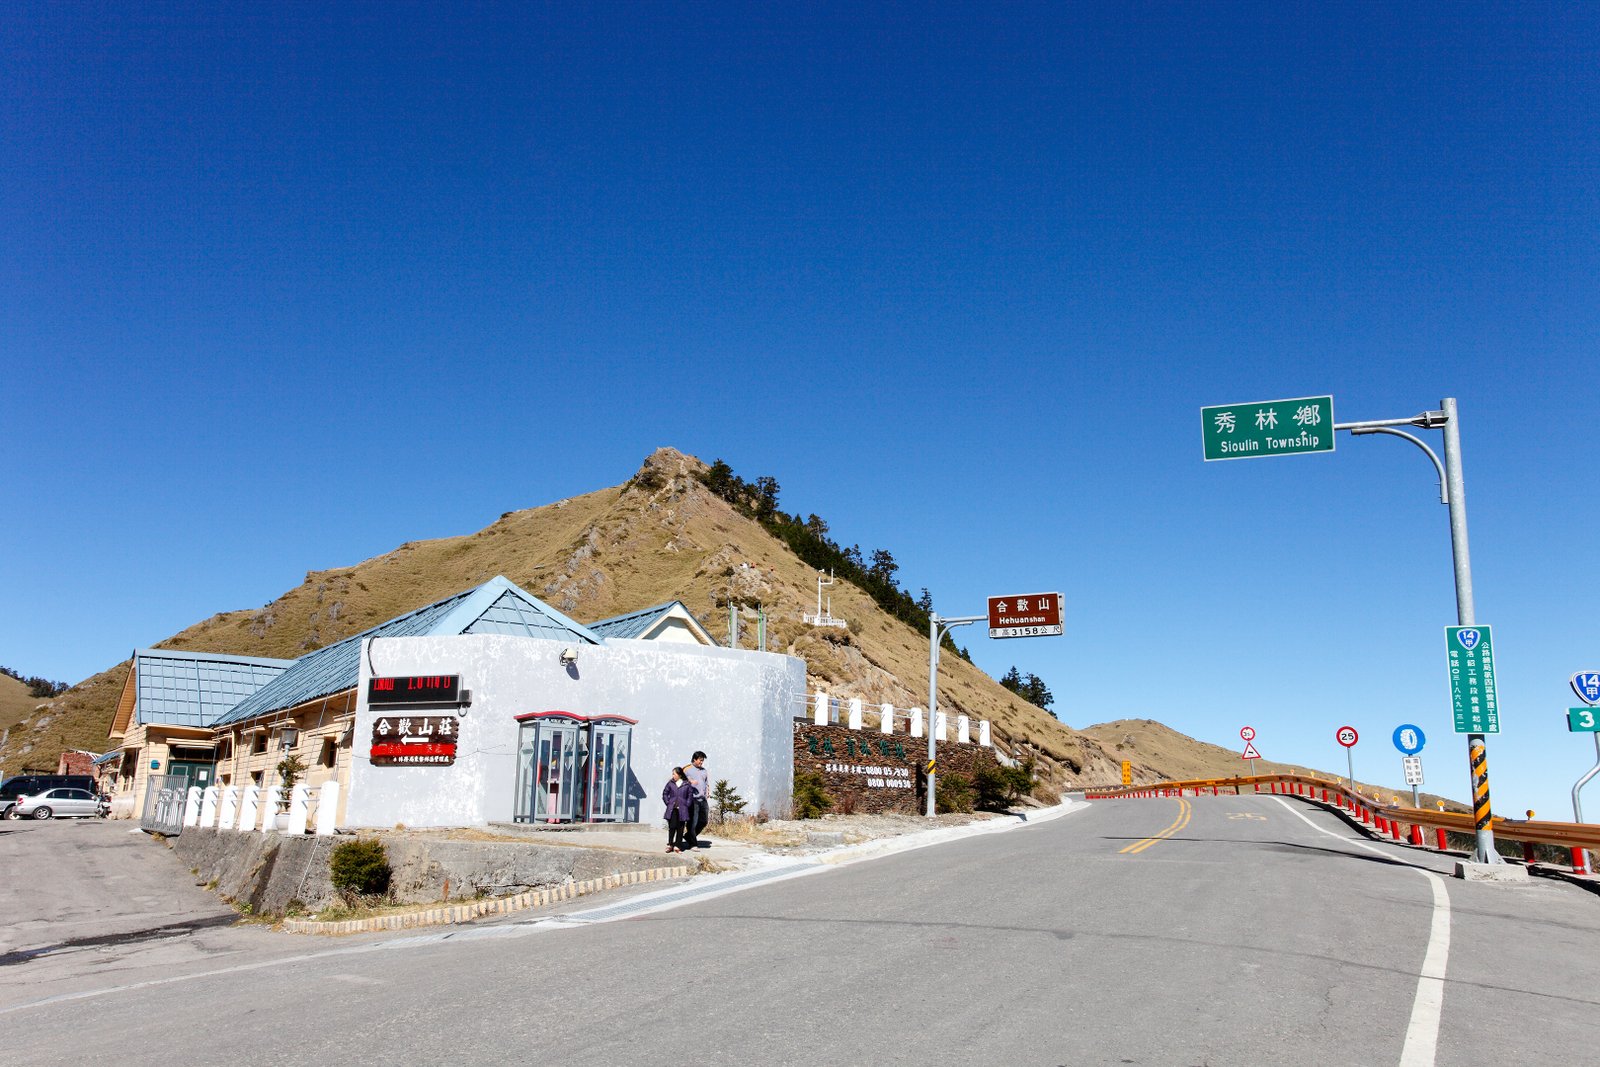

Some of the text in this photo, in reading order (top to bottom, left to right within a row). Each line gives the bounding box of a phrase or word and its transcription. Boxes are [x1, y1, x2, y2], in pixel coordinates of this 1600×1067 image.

[1214, 404, 1321, 433] 秀林鄉
[1220, 434, 1320, 453] Sioulin Township
[996, 597, 1050, 613] 合歡山
[999, 616, 1046, 625] Hehuanshan
[1462, 631, 1475, 639] 14
[1465, 639, 1474, 647] 甲
[1580, 674, 1600, 687] 14
[1586, 687, 1598, 699] 甲
[1578, 710, 1595, 728] 3
[376, 718, 453, 736] 合歡山莊
[1341, 732, 1354, 741] 25
[1225, 812, 1268, 821] 25
